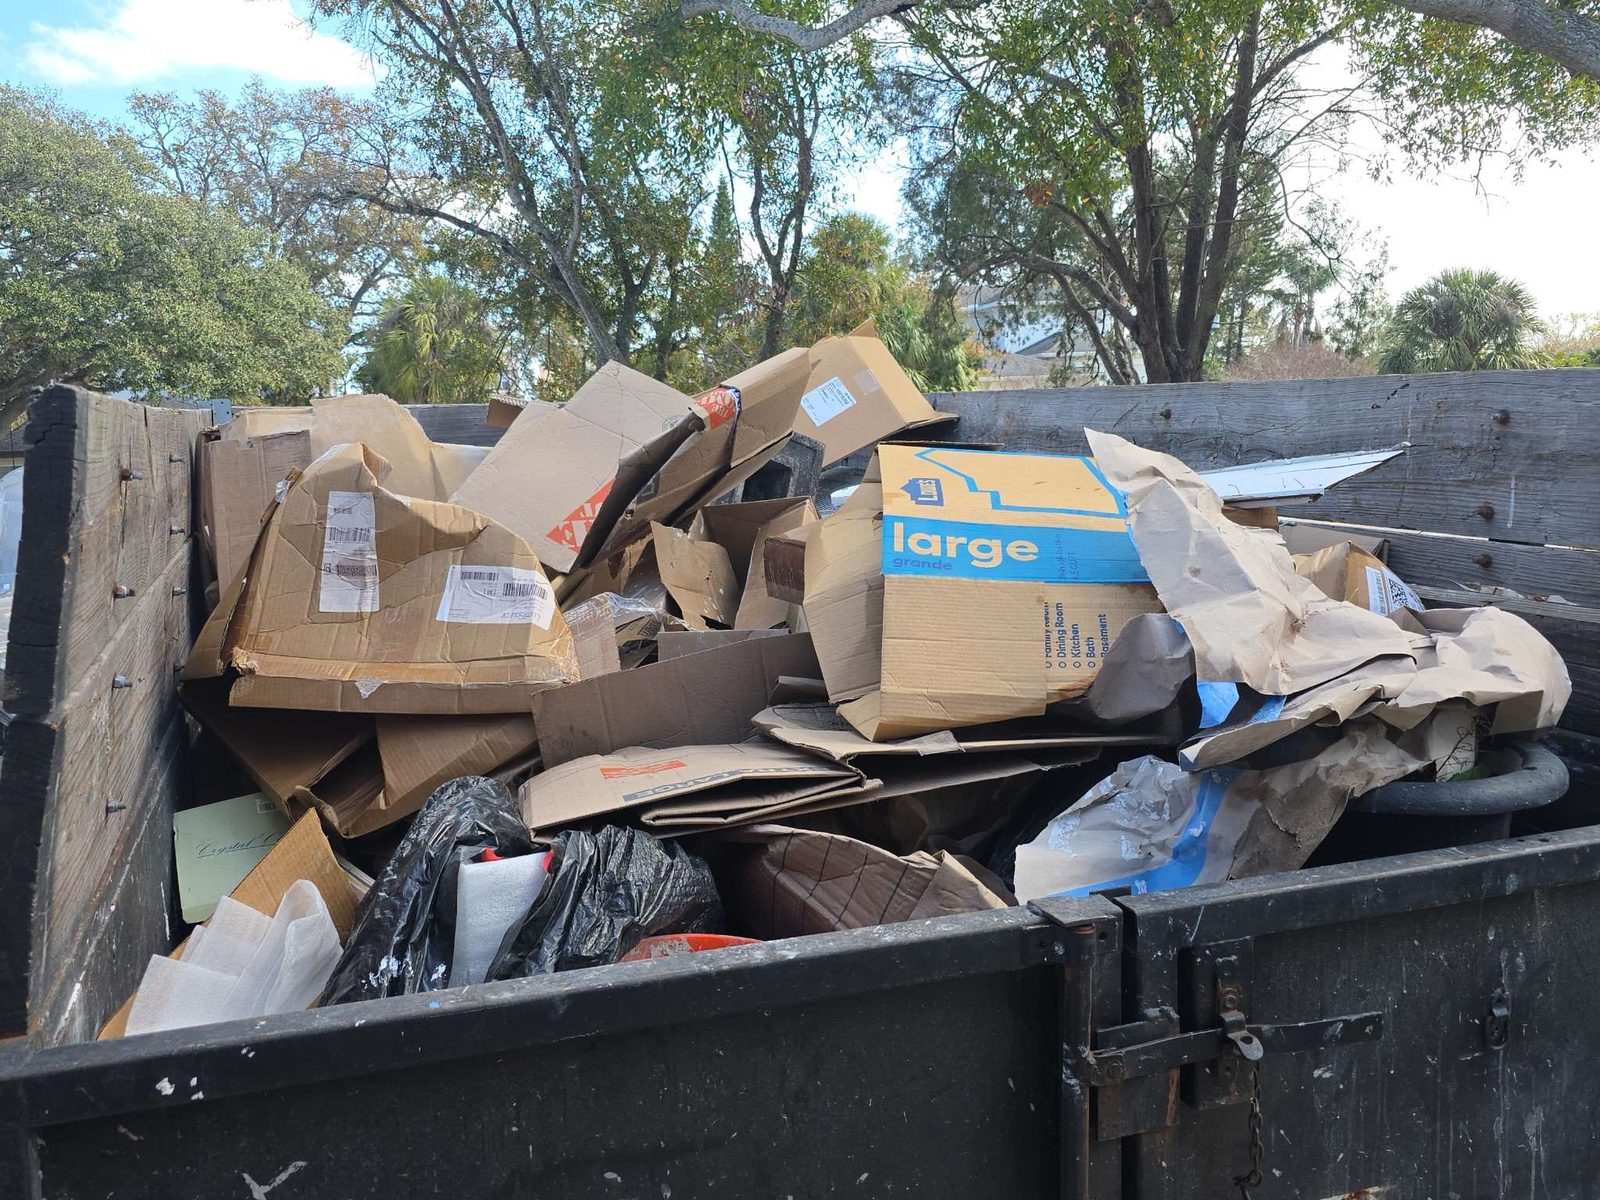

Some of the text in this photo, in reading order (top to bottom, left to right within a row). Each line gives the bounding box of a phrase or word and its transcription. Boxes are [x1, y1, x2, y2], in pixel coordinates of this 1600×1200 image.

[894, 522, 1039, 568] large
[893, 557, 952, 570] grande
[1054, 602, 1067, 658] Dining Room
[1070, 623, 1081, 658] Kitchen
[1084, 637, 1096, 658] Bath
